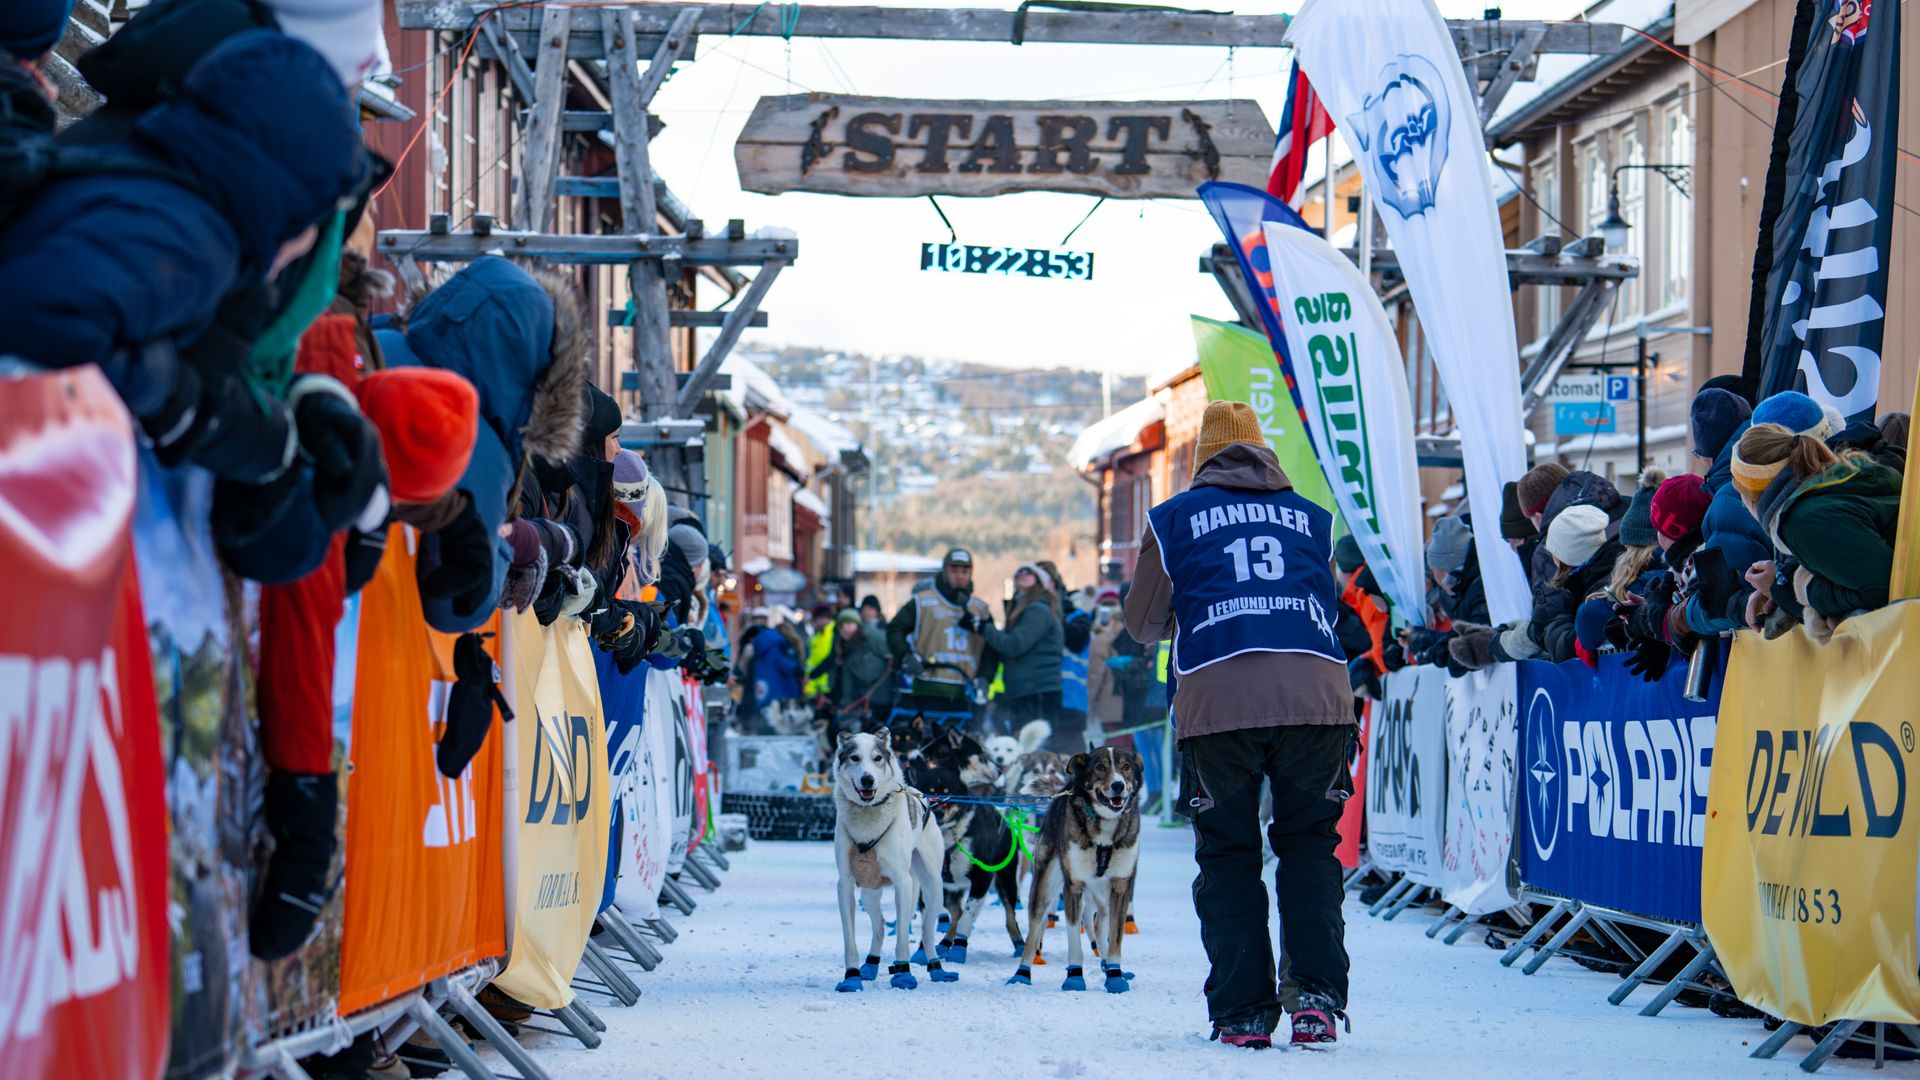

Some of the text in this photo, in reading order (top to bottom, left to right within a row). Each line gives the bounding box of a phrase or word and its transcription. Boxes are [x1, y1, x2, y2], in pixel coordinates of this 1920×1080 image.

[843, 112, 1172, 175] START
[926, 243, 1092, 280] 10:22:53
[1189, 503, 1313, 540] HANDLER
[1223, 535, 1285, 583] 13
[1792, 887, 1842, 924] 1853
